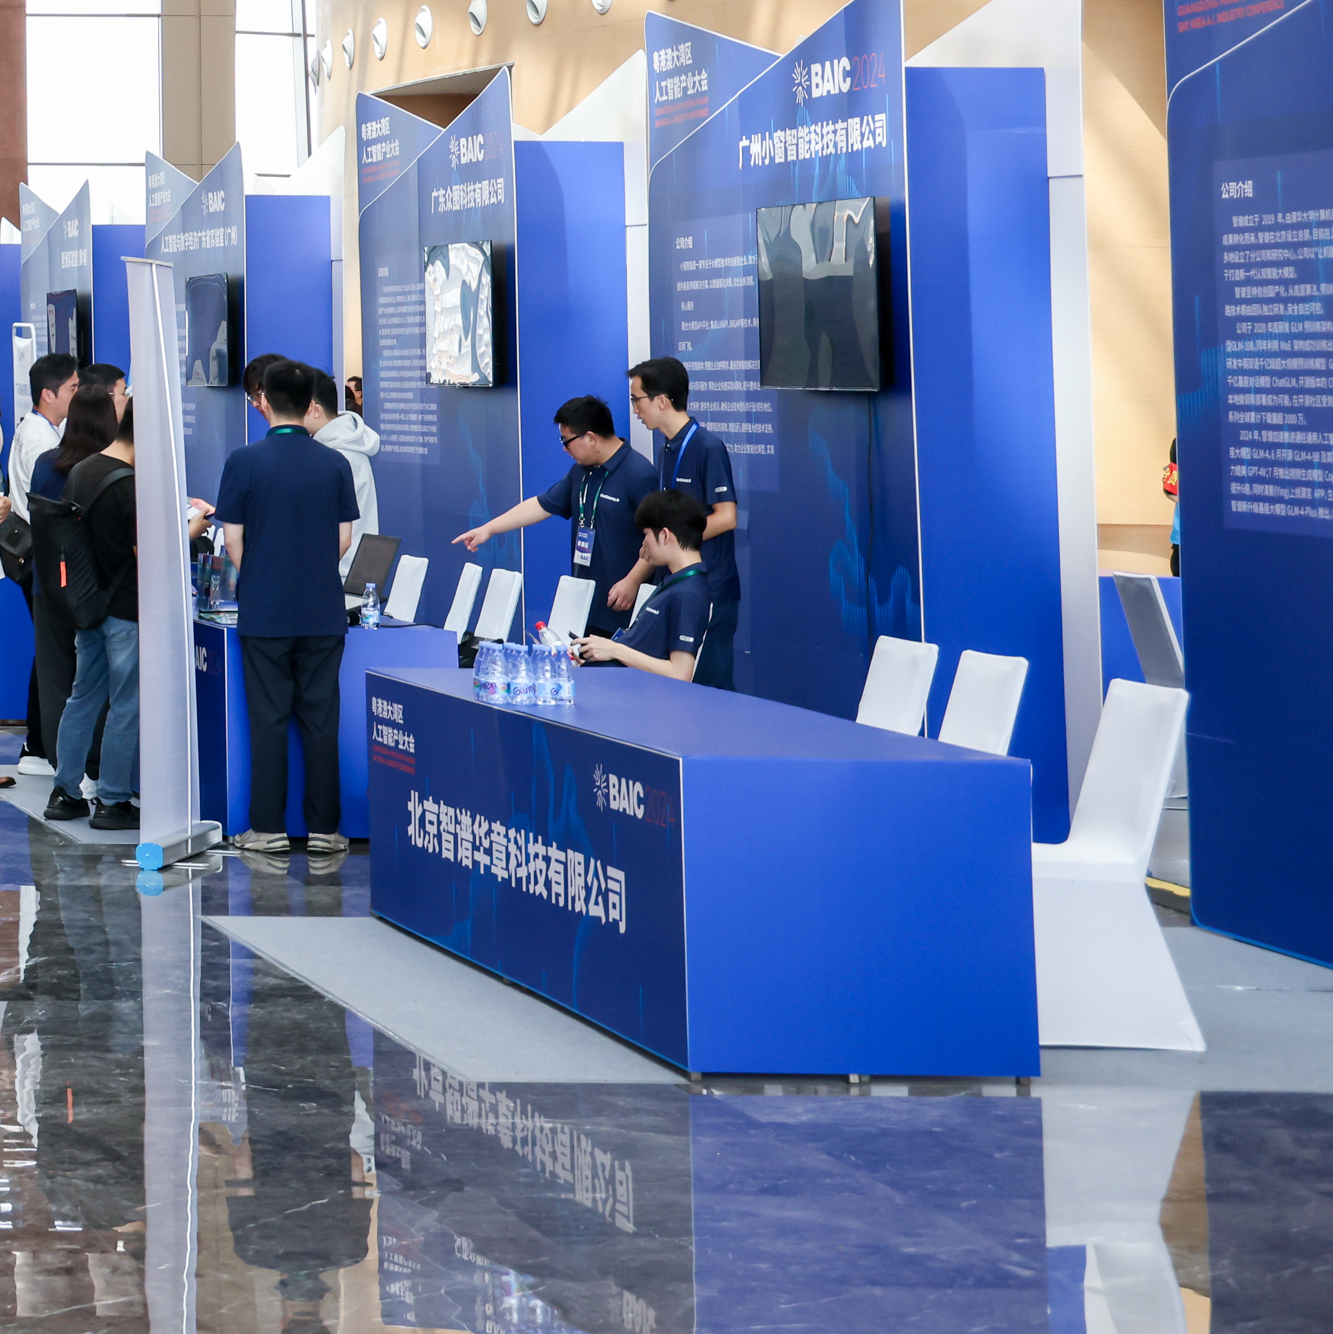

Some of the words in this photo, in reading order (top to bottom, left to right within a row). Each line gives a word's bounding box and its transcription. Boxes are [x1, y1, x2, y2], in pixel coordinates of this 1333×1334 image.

[652, 41, 693, 72] 粤港澳大湾区
[654, 68, 709, 104] 人工智能产业大会
[810, 57, 851, 99] BAIC
[851, 52, 887, 92] 2024
[361, 116, 391, 142] 粤港澳大湾区
[738, 113, 887, 170] 广州小窗智能科技有限公司
[361, 137, 400, 165] 人工智能产业大会
[459, 134, 484, 165] BAIC
[208, 190, 225, 214] BAIC
[431, 177, 505, 214] 广东众图科技有限公司
[1221, 180, 1253, 199] 公司介绍
[67, 219, 80, 239] BAIC
[1239, 430, 1252, 442] 2024
[371, 695, 404, 725] 粤港澳大湾区
[371, 721, 416, 754] 人工智能产业大会
[608, 772, 645, 820] BAIC
[407, 789, 627, 934] 北京智谱华章科技有限公司
